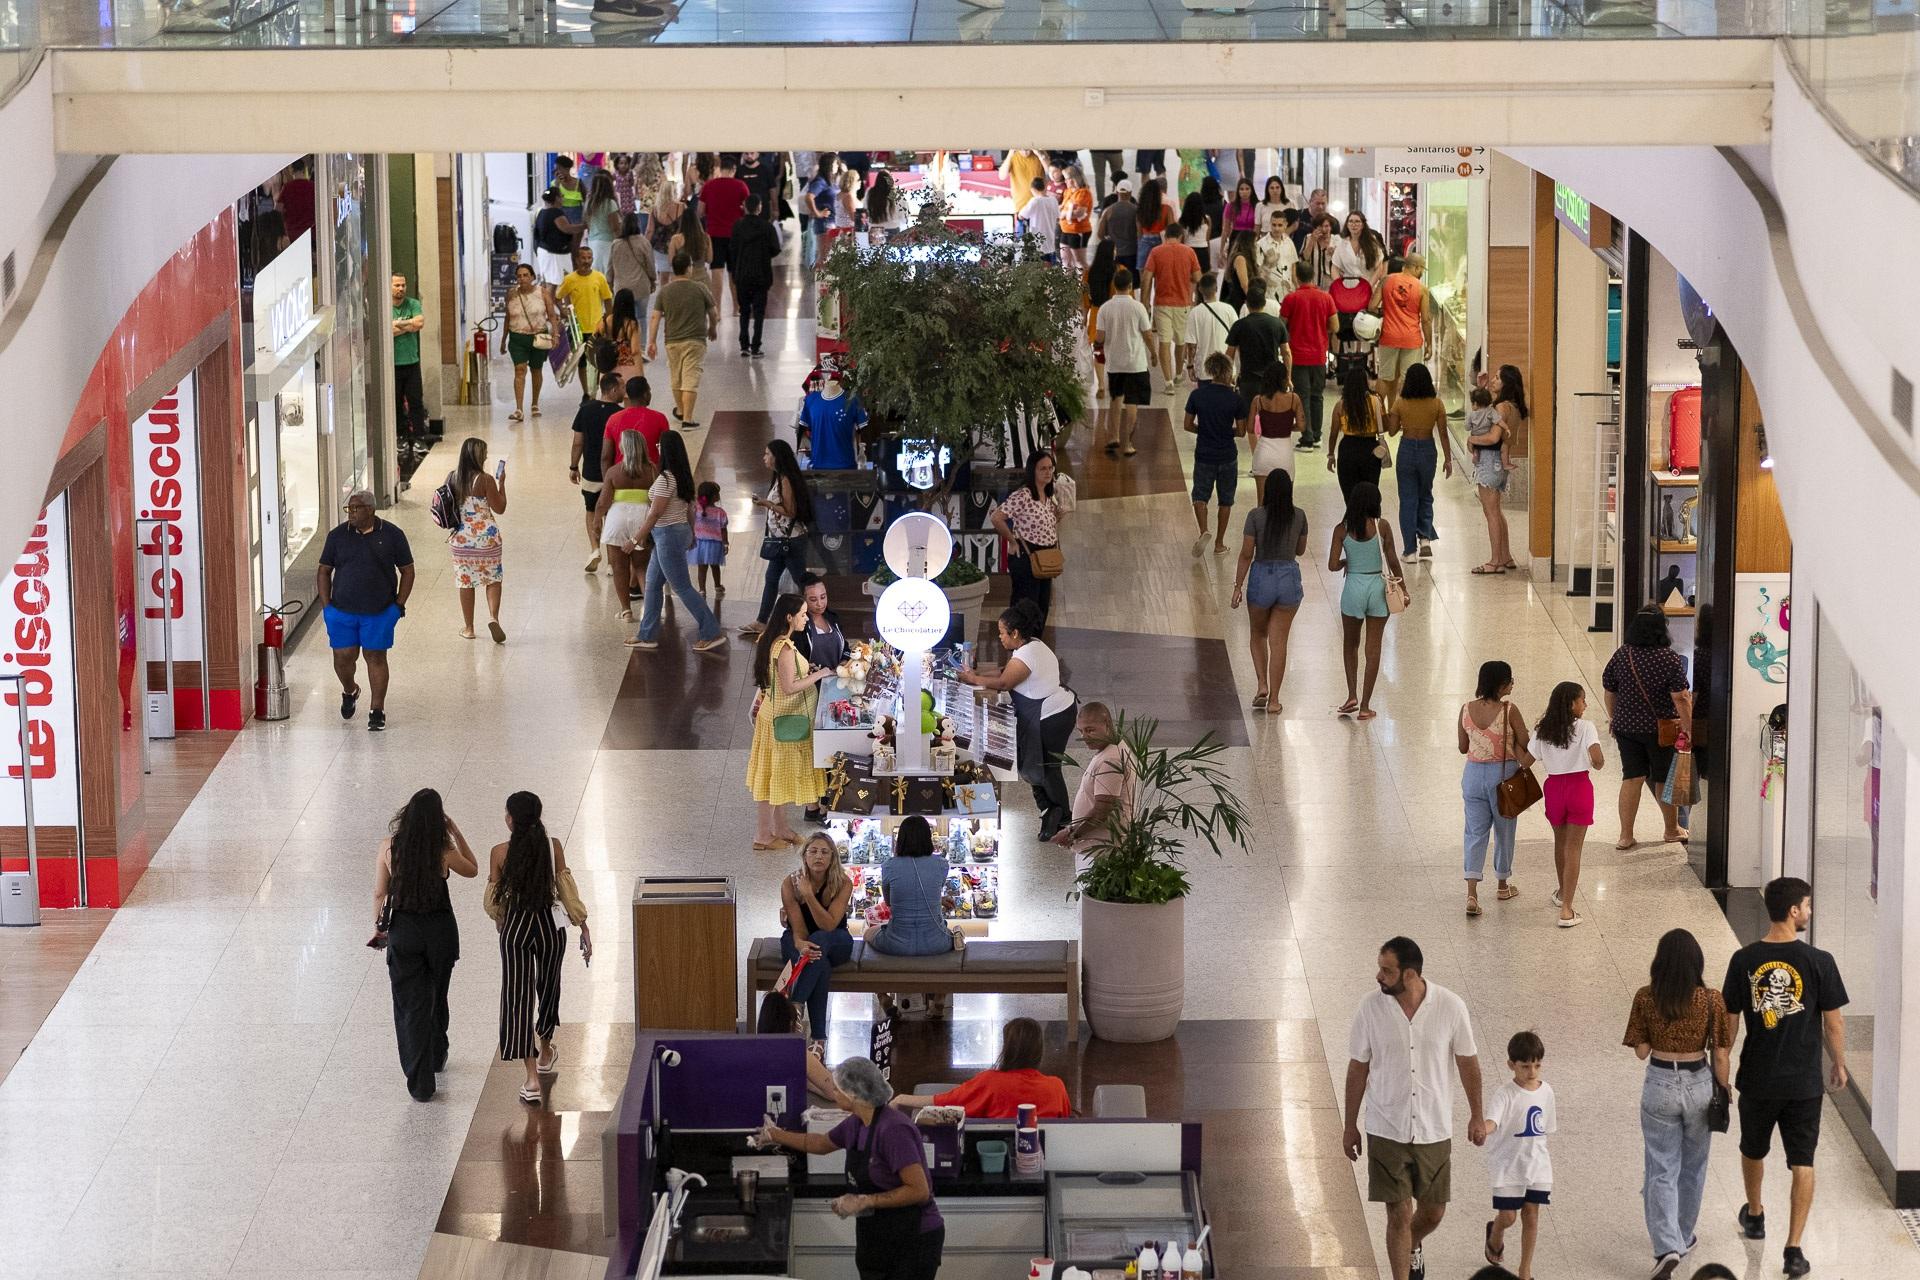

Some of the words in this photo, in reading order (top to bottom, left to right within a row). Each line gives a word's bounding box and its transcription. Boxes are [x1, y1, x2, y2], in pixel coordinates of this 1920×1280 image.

[1384, 164, 1417, 175] Espaço
[1421, 163, 1455, 173] Família
[8, 719, 57, 780] Le
